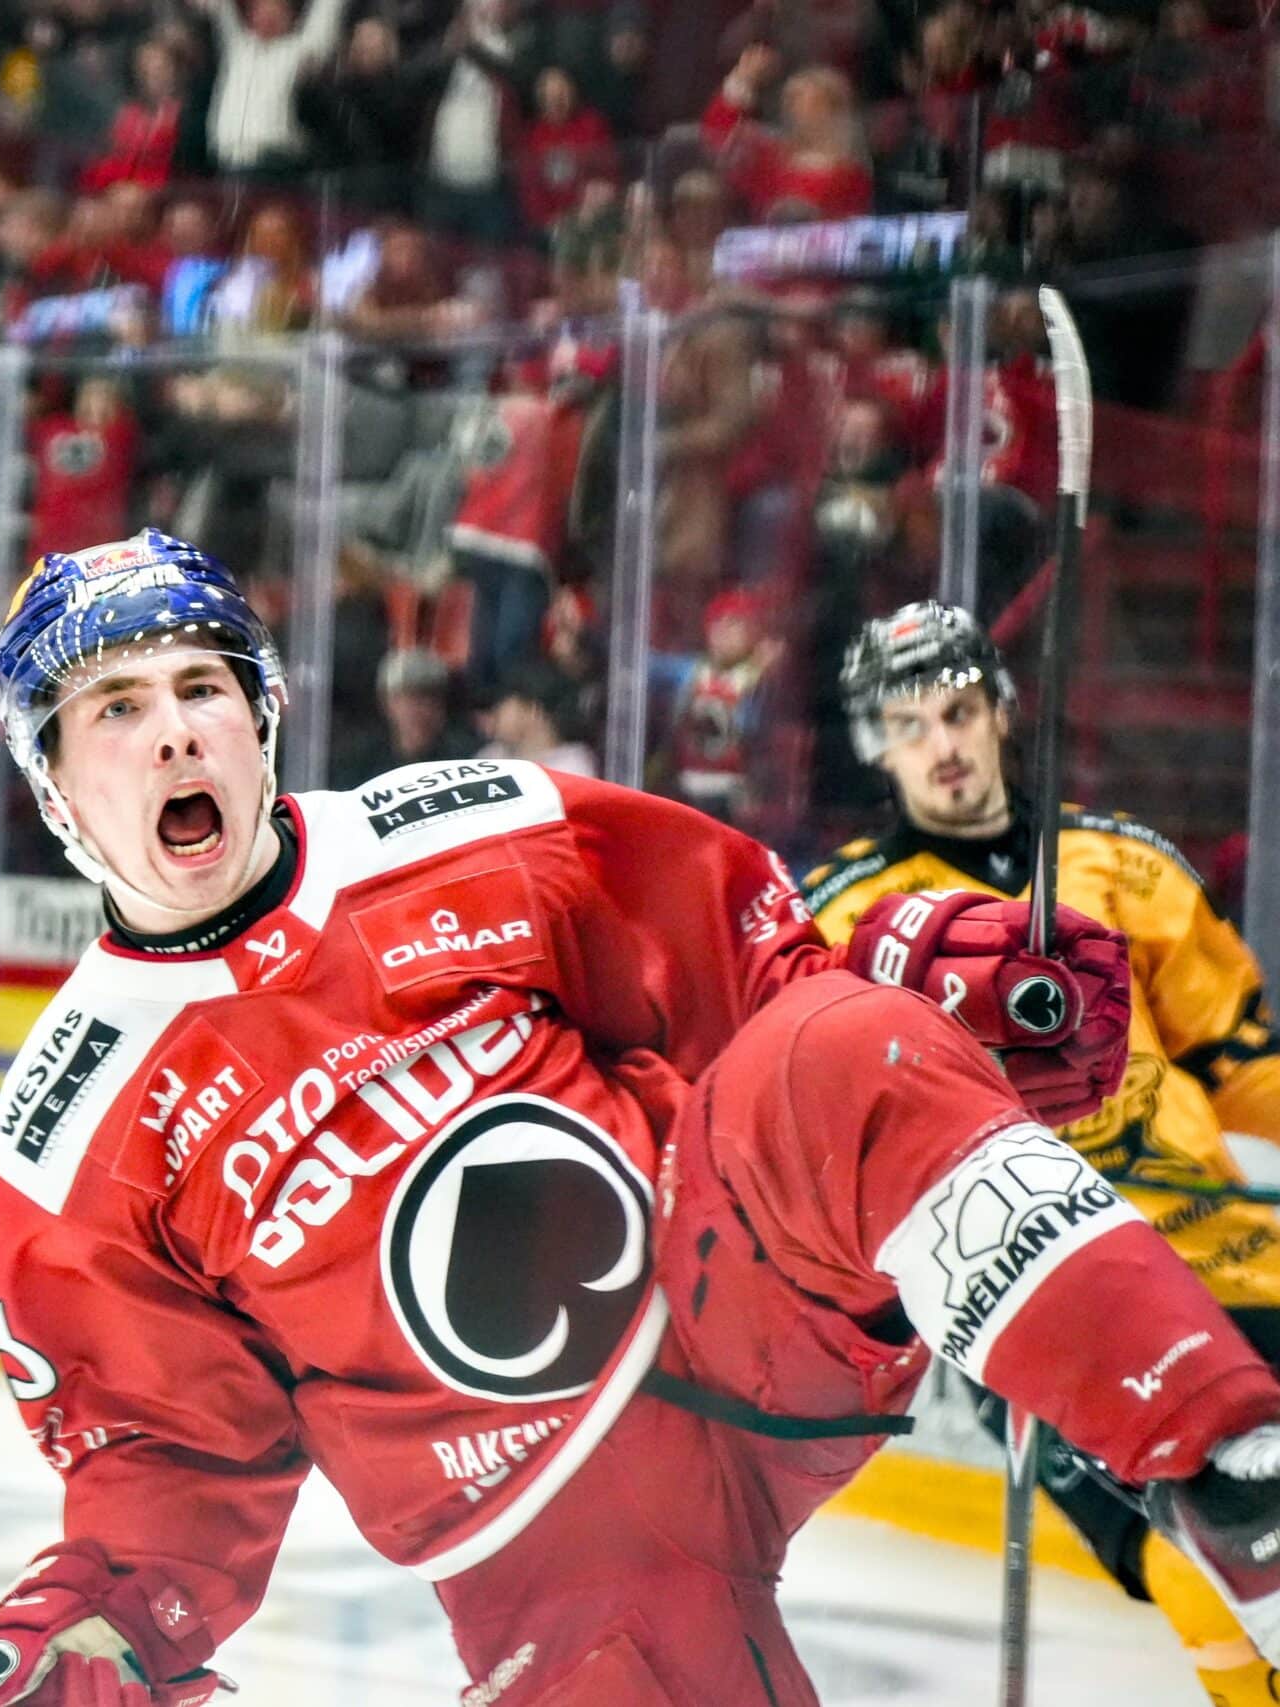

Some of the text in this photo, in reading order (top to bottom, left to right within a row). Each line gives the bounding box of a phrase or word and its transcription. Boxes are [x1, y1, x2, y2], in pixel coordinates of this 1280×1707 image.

[361, 761, 499, 811] WESTAS
[384, 782, 509, 827] HELA
[382, 920, 532, 968] OLMAR
[0, 1009, 83, 1137] WESTAS
[24, 1039, 110, 1148] HELA
[164, 1066, 245, 1187] UPART
